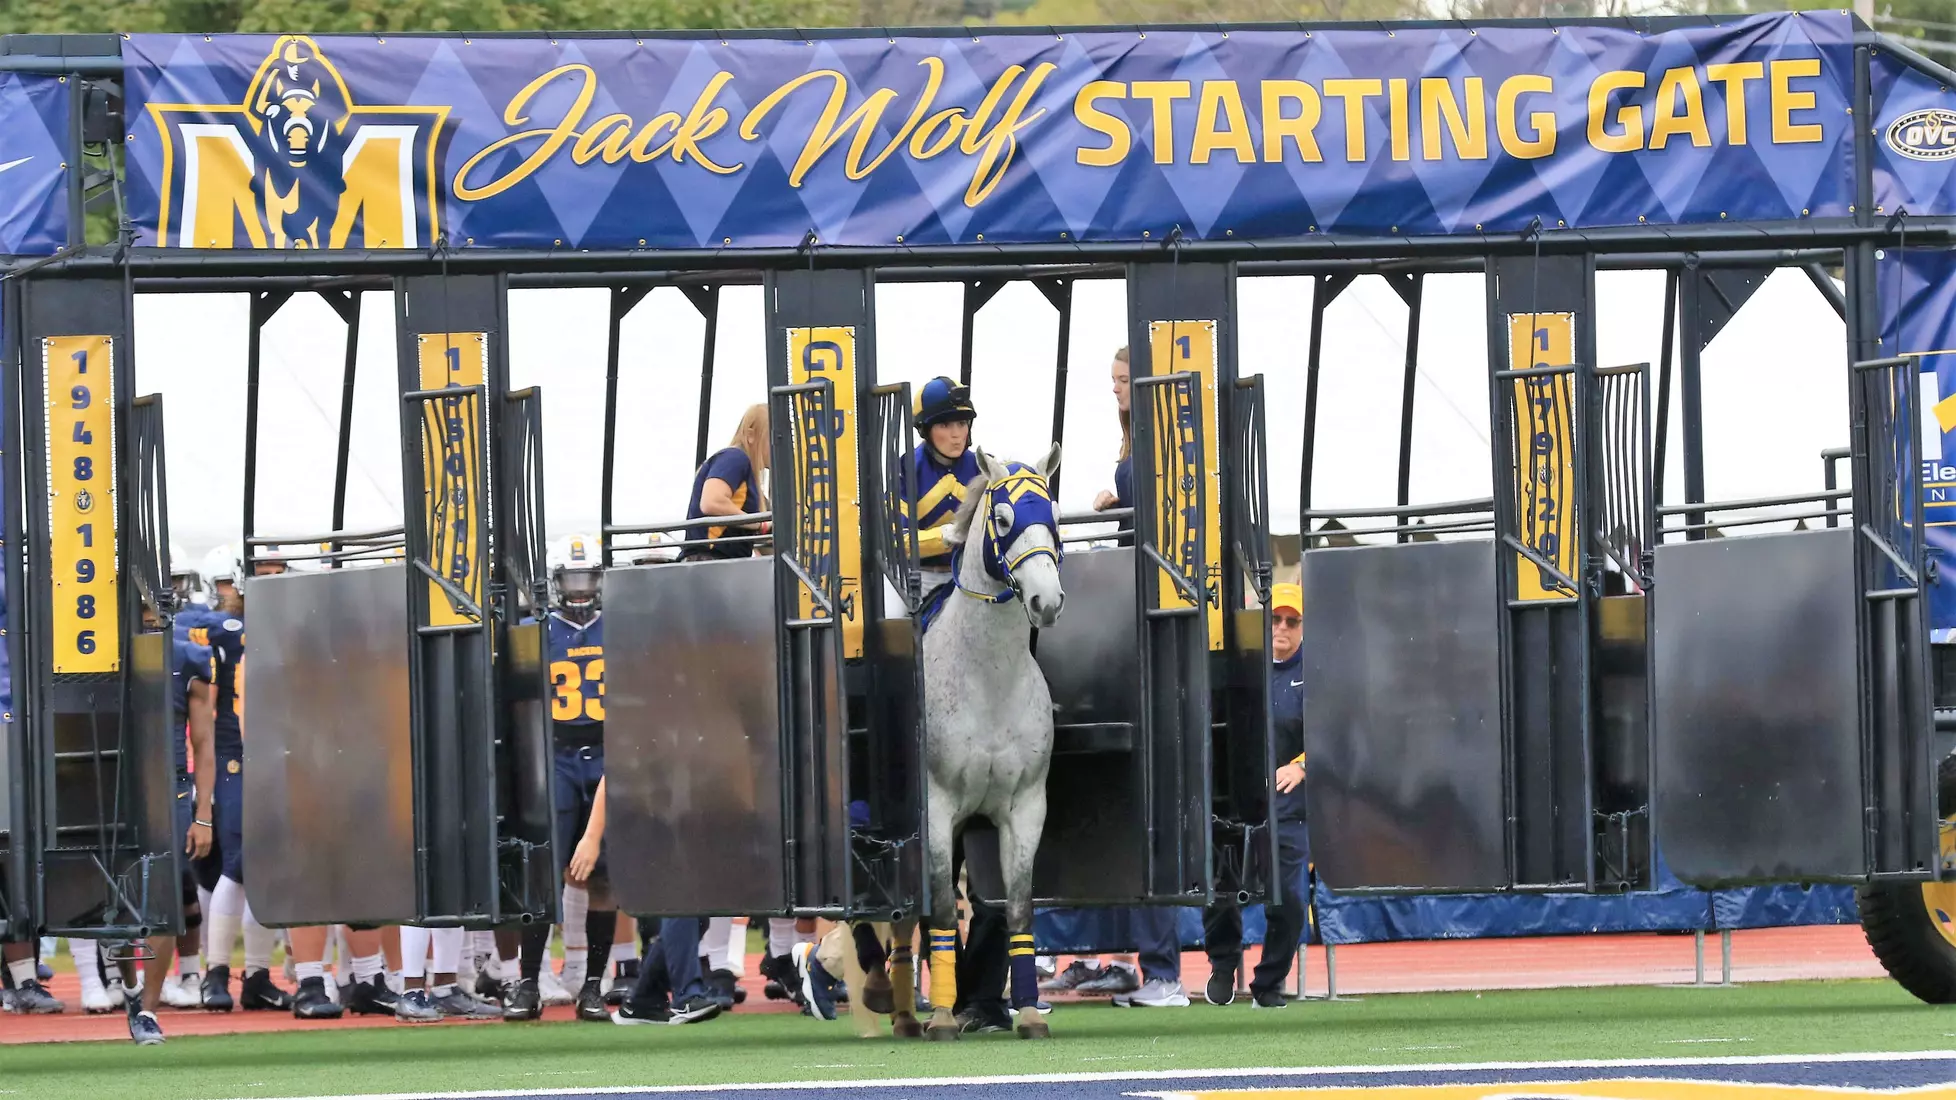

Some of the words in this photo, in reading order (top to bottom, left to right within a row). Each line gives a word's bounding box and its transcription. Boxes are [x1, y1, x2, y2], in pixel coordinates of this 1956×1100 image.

[453, 65, 744, 202] Jack
[739, 57, 1054, 208] Wolf
[1074, 73, 1558, 167] STARTING
[1586, 58, 1823, 153] GATE
[1905, 125, 1956, 146] OVC
[70, 350, 94, 481] 1948
[75, 523, 97, 656] 1986
[549, 659, 606, 721] 33
